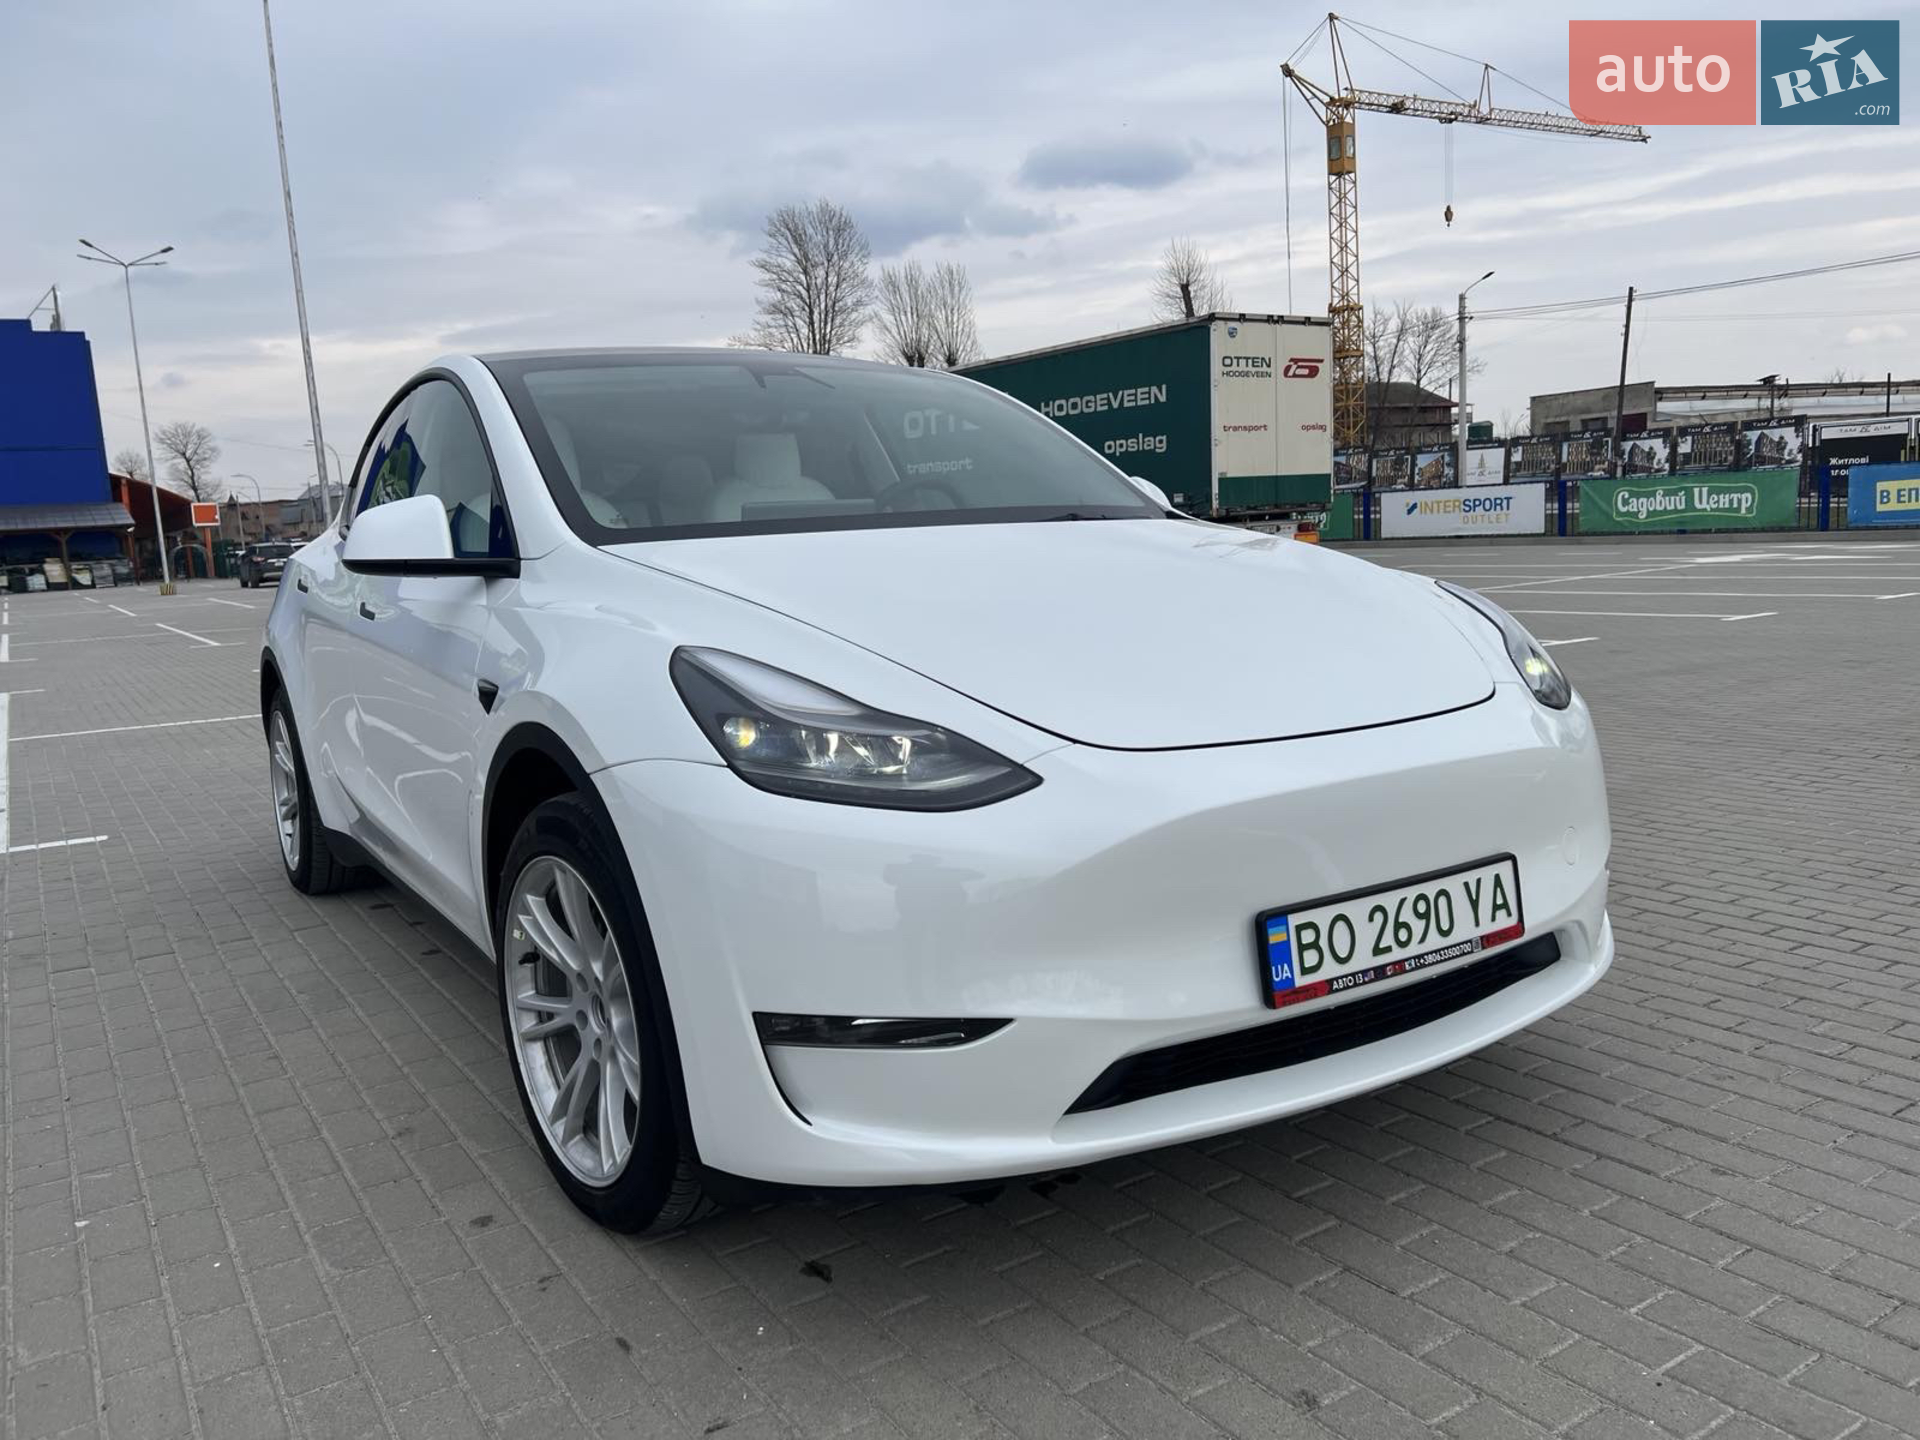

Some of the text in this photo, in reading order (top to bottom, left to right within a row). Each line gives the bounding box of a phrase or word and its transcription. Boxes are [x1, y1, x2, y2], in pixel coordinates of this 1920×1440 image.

[1221, 356, 1272, 368] OTTEN
[1221, 370, 1272, 378] HOOGEVEEN
[1041, 384, 1167, 418] HOOGEVEEN
[1223, 423, 1327, 433] transport opslag
[1103, 433, 1167, 457] opslag
[906, 457, 973, 475] transport
[1829, 455, 1870, 466] Житлові
[1419, 496, 1513, 515] INTERSPORT
[1616, 486, 1753, 519] Садовий Центр
[1880, 489, 1891, 505] В
[1462, 513, 1511, 525] OUTLET
[1295, 873, 1512, 976] BO 2690 YA
[1271, 963, 1292, 982] UA
[1332, 976, 1355, 991] АВТО
